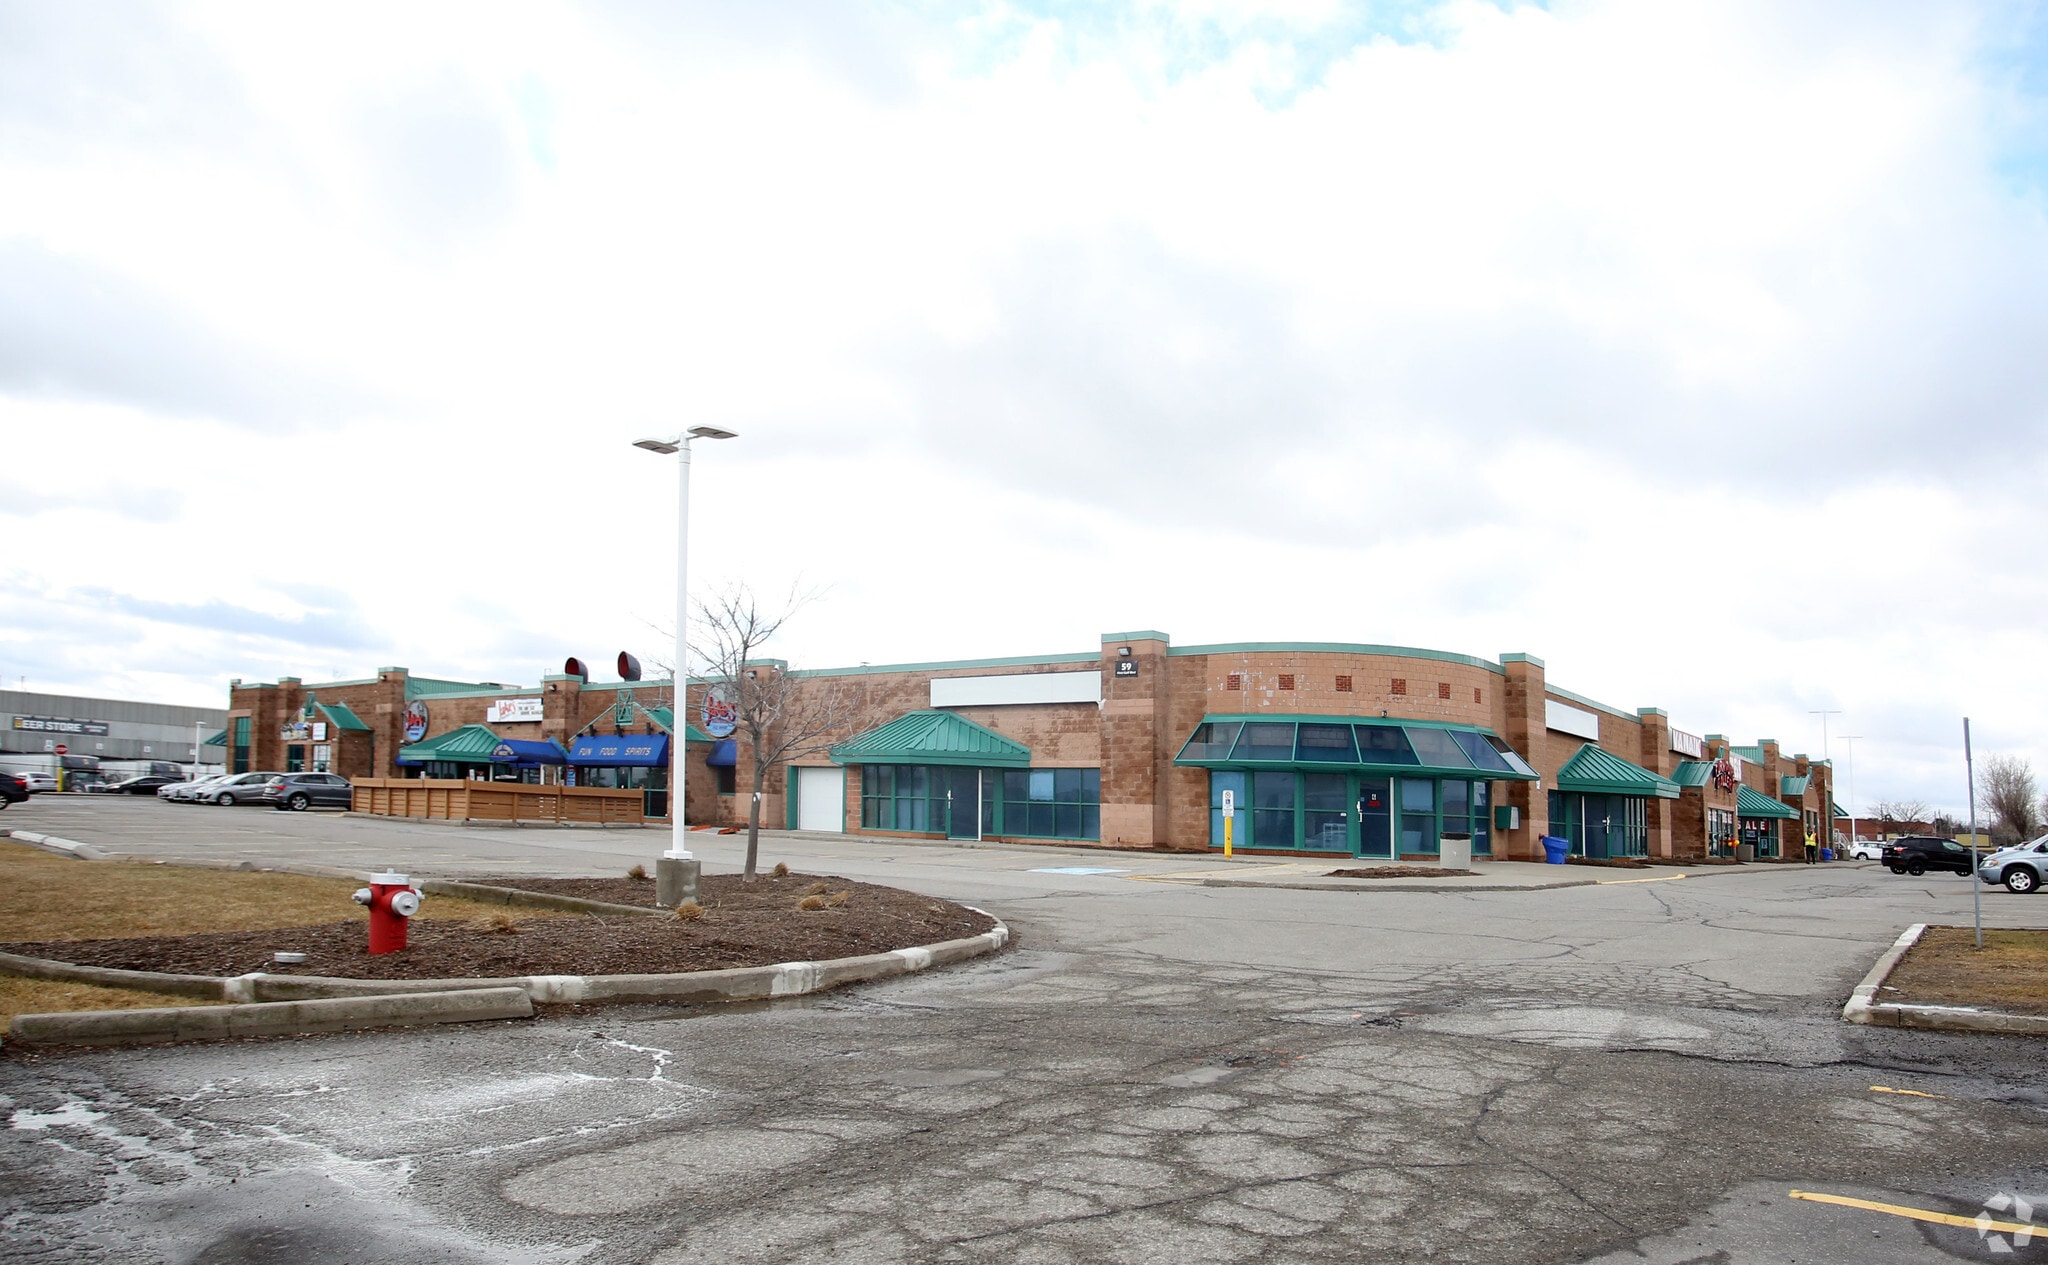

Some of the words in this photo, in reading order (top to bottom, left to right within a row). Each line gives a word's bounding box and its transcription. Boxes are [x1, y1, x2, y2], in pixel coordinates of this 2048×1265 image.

[1121, 662, 1132, 671] 59
[45, 721, 83, 732] STORE
[578, 747, 593, 756] FUN
[599, 747, 618, 756] FOOD
[624, 747, 652, 756] SPIRITS
